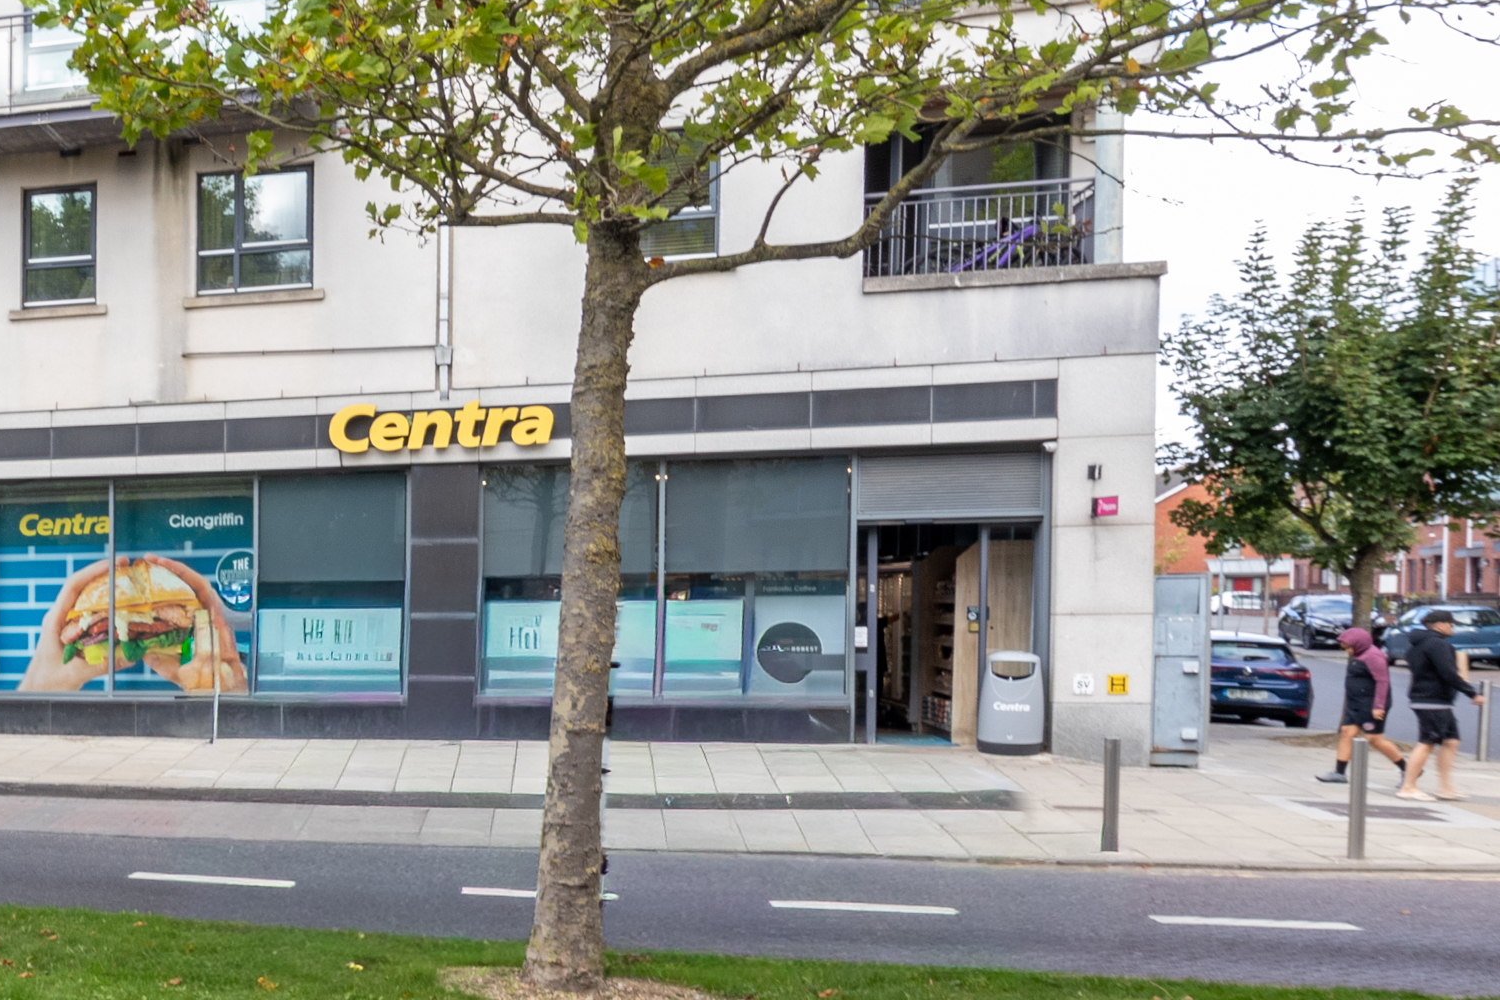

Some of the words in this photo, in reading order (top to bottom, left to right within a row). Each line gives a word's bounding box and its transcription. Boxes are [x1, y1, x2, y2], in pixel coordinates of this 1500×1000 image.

[328, 399, 555, 453] Centra
[19, 512, 110, 537] Centra
[169, 512, 244, 530] Clongriffin
[232, 556, 250, 571] THE
[1110, 676, 1126, 692] H
[993, 701, 1031, 712] Centra
